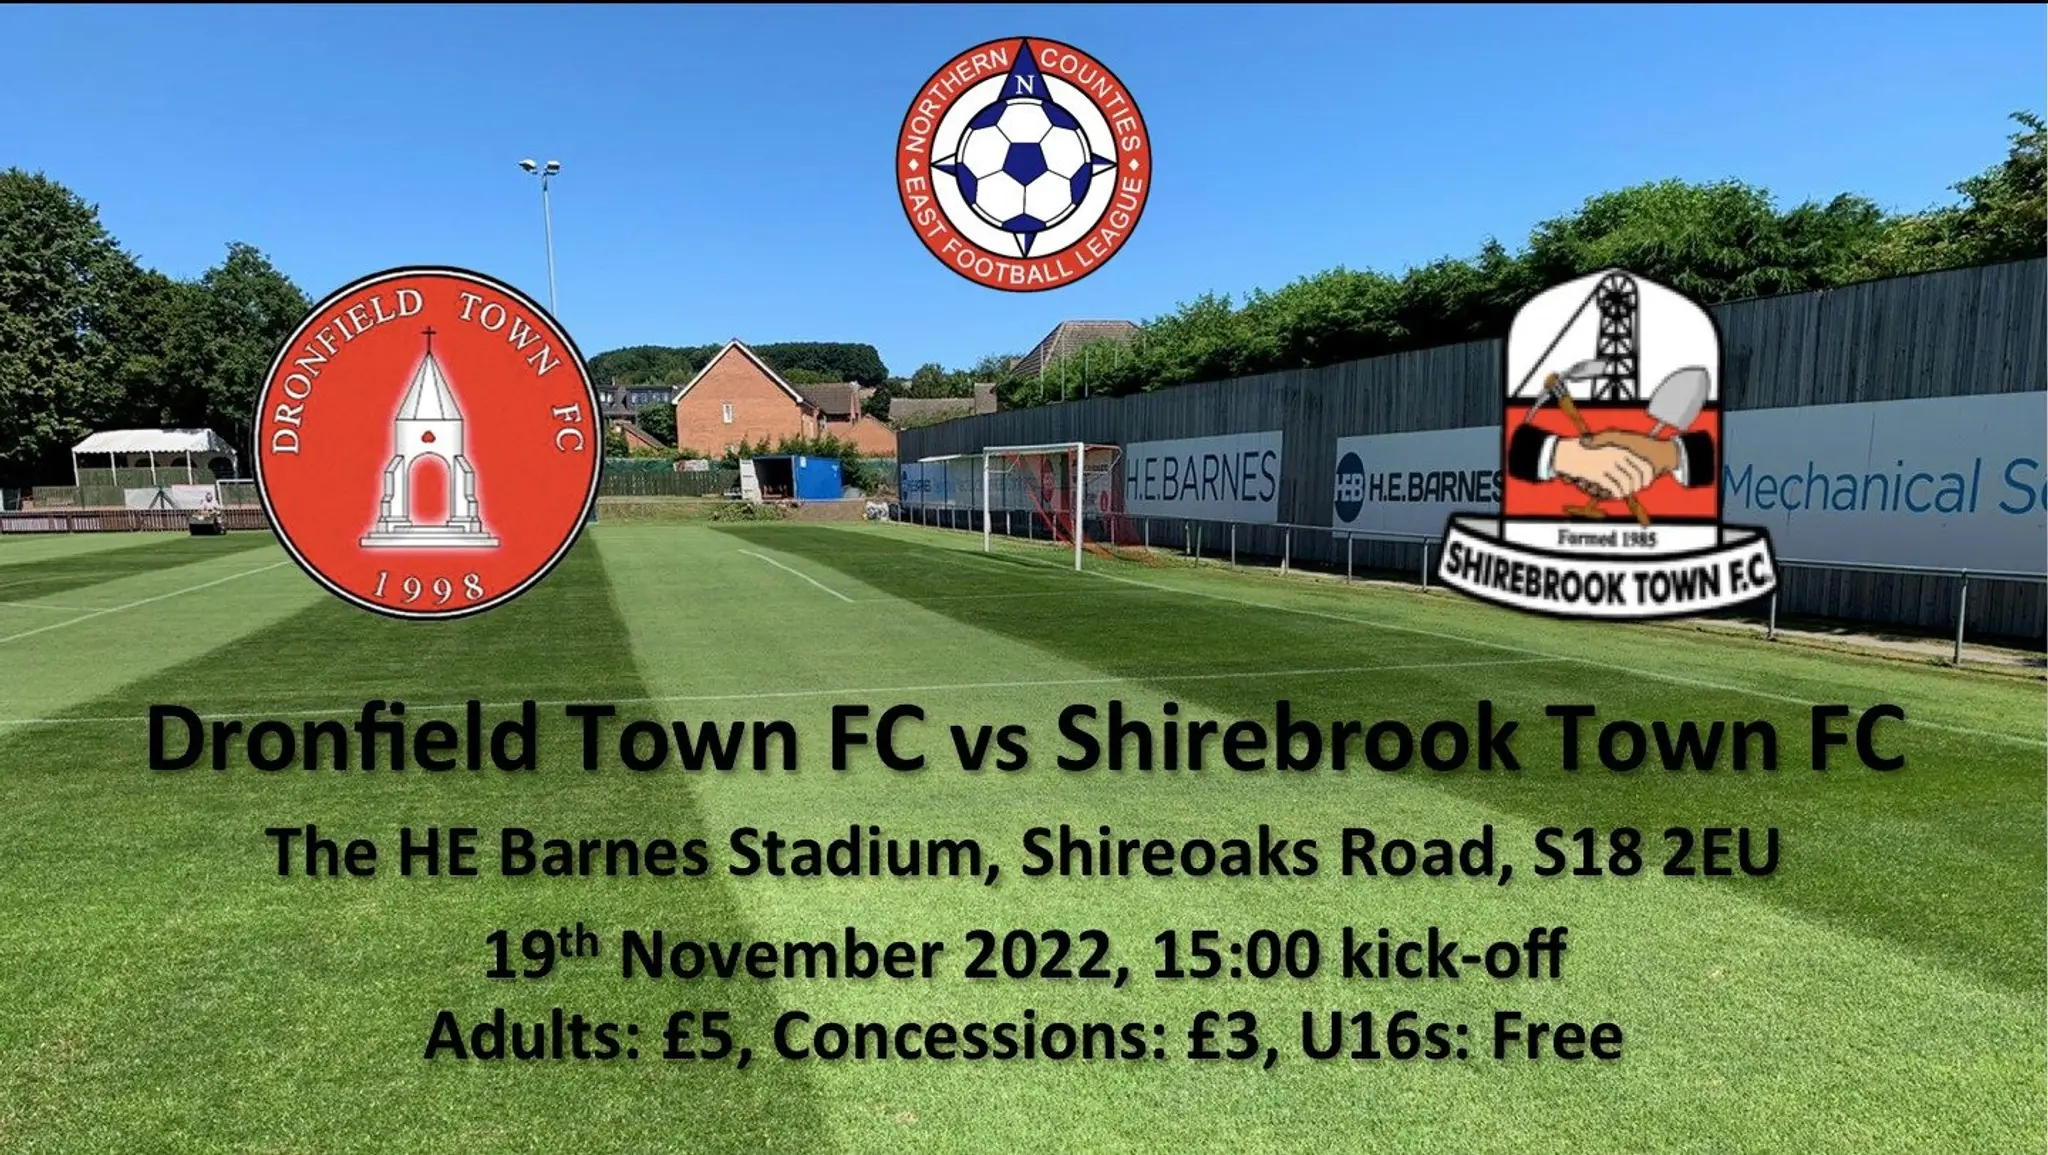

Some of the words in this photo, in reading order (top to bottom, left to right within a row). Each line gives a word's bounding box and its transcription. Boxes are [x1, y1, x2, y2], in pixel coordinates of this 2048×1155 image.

[1126, 450, 1276, 502] H.E.BARNES
[1723, 456, 1981, 514] Mechanical
[1999, 457, 2048, 515] S
